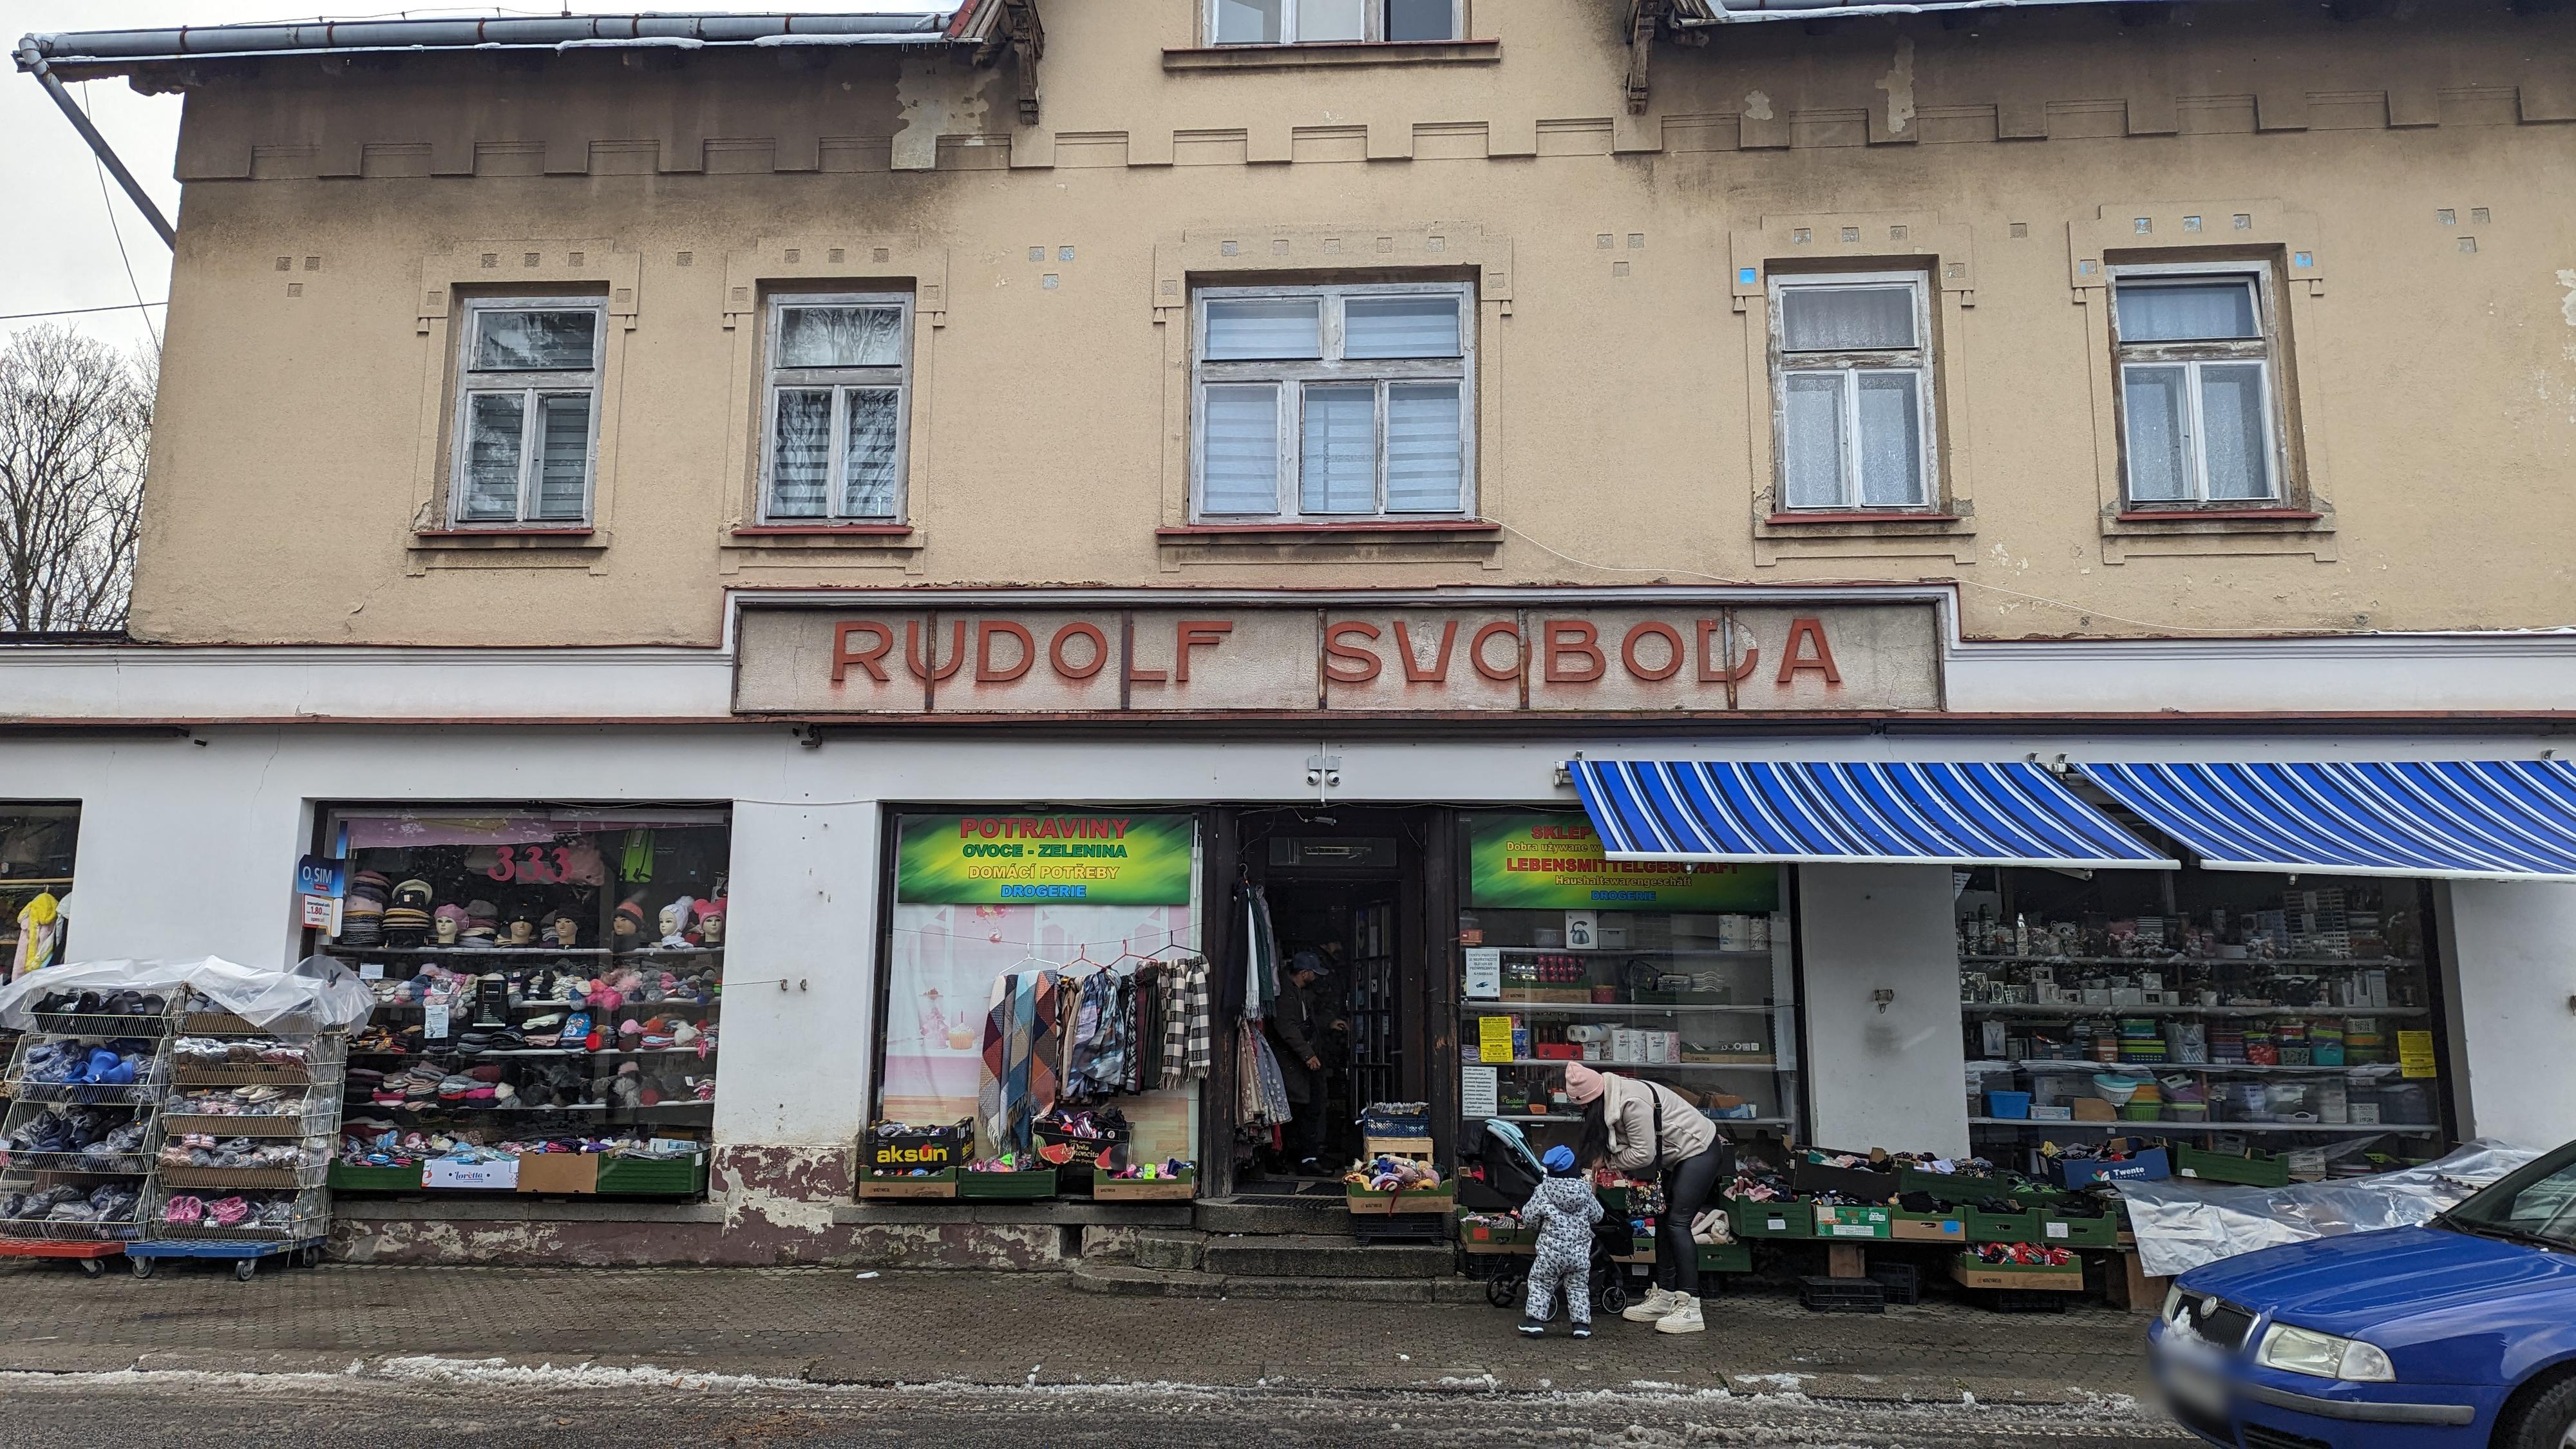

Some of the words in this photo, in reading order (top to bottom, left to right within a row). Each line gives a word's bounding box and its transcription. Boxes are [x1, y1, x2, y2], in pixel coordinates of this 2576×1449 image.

[831, 620, 1233, 681] RUDOLF
[1325, 618, 1841, 683] SVOBODA
[960, 817, 1131, 839] POTRAVINY
[1531, 825, 1593, 840] SKLEP
[962, 844, 1024, 858] OVOCE
[1037, 844, 1128, 858] ZELENINA
[1506, 842, 1539, 852] Dobra
[1540, 842, 1589, 854] używane
[487, 845, 572, 882] 333
[314, 867, 332, 884] SIM
[968, 863, 1037, 880] DOMÁCÍ
[1040, 864, 1121, 880] POTŘEBY
[1555, 875, 1692, 887] Haushaltswarengeschäft
[1000, 885, 1087, 898] DROGERIE
[1591, 891, 1657, 901] DROGERIE
[311, 906, 323, 915] 1.80
[876, 1144, 947, 1163] aksun
[1070, 1142, 1089, 1151] Doña
[2113, 1167, 2145, 1176] Twente
